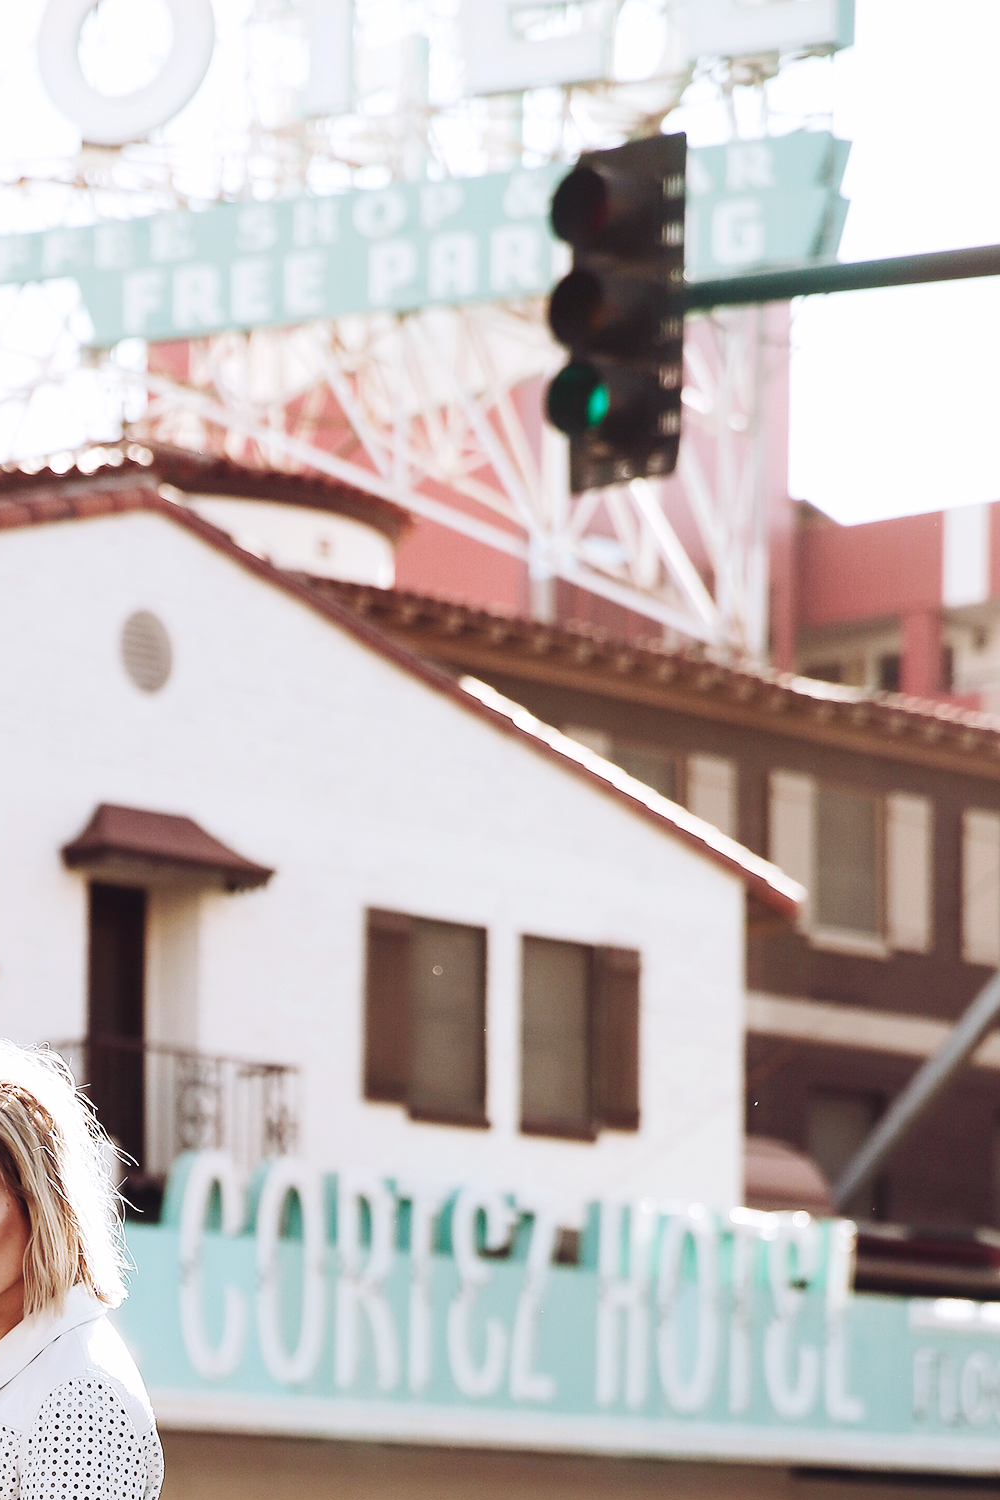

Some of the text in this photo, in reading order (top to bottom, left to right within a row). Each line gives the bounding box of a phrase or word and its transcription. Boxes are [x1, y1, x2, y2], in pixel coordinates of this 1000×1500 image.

[236, 182, 464, 251] SHOP
[123, 249, 327, 338] FREE
[179, 1150, 866, 1422] CORTEZ HOTEL
